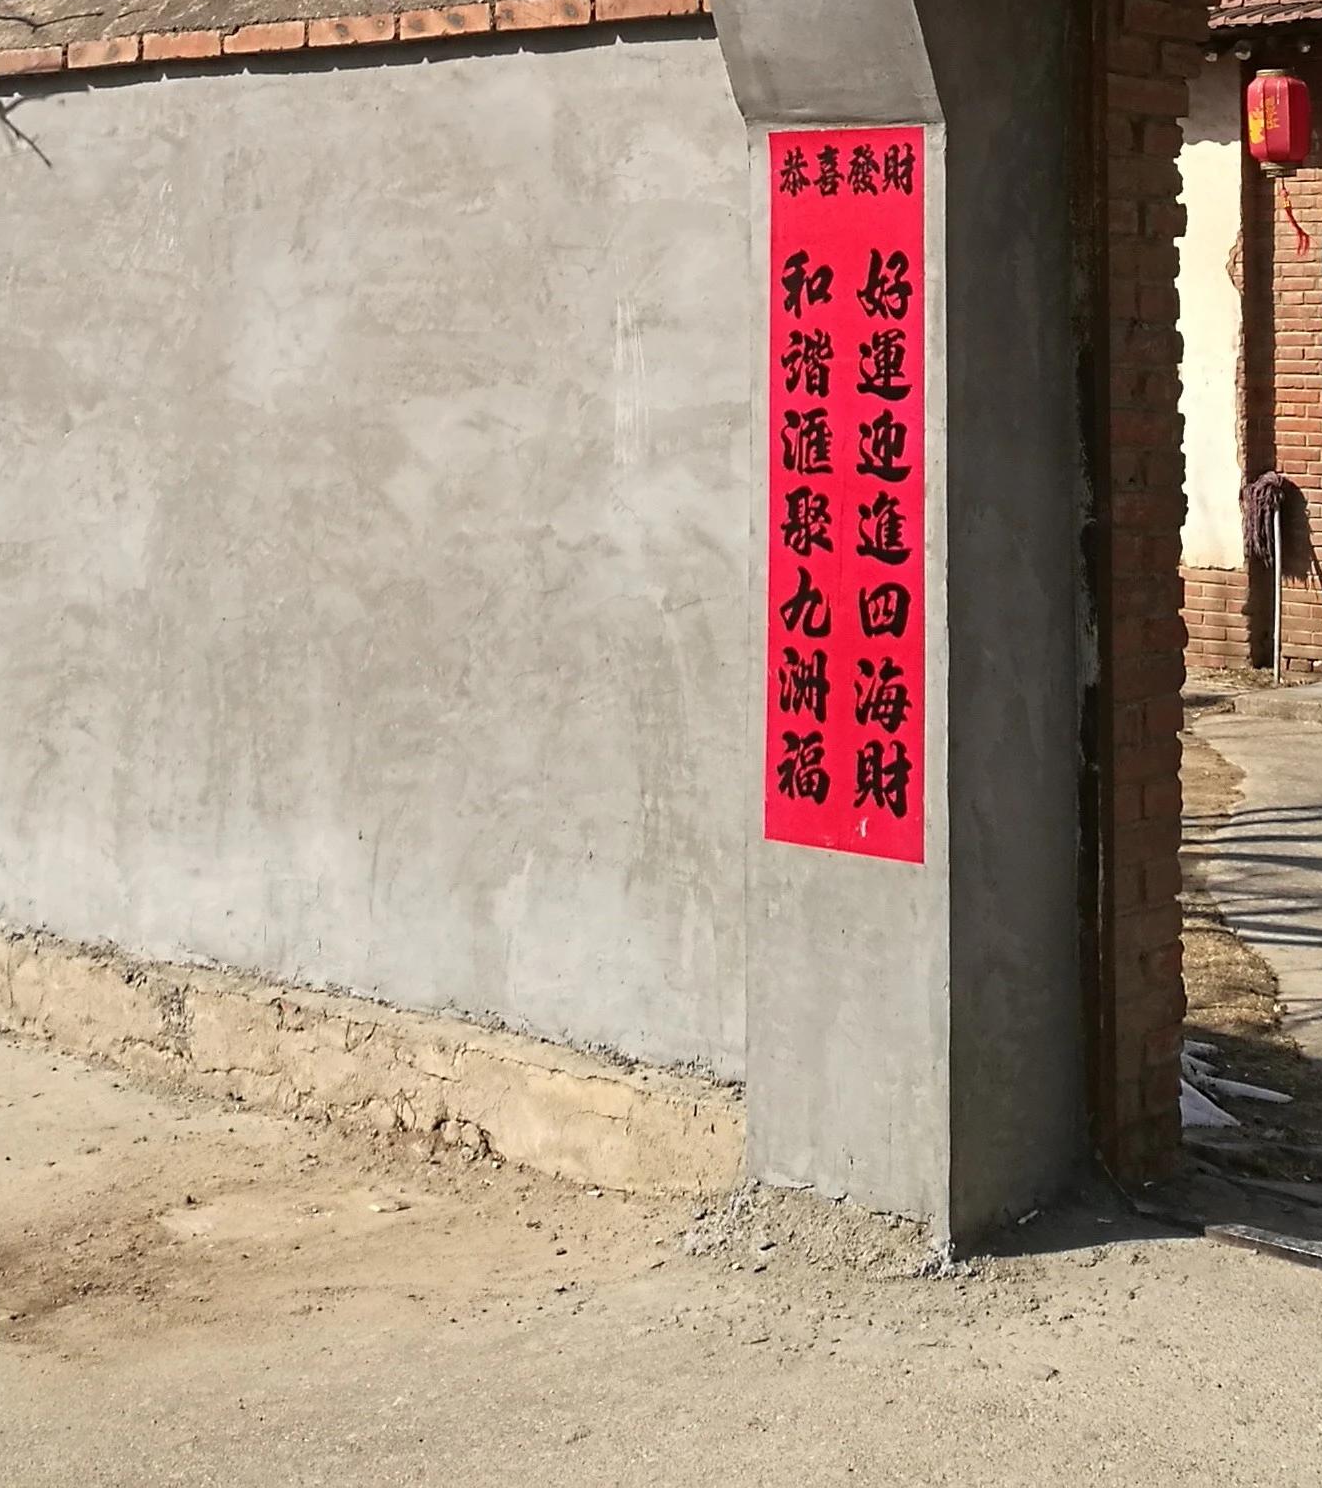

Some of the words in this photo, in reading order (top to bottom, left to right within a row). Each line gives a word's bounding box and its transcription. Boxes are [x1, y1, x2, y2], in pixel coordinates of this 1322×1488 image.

[780, 143, 915, 196] 恭喜發財
[853, 248, 913, 819] 好運迎進四海財
